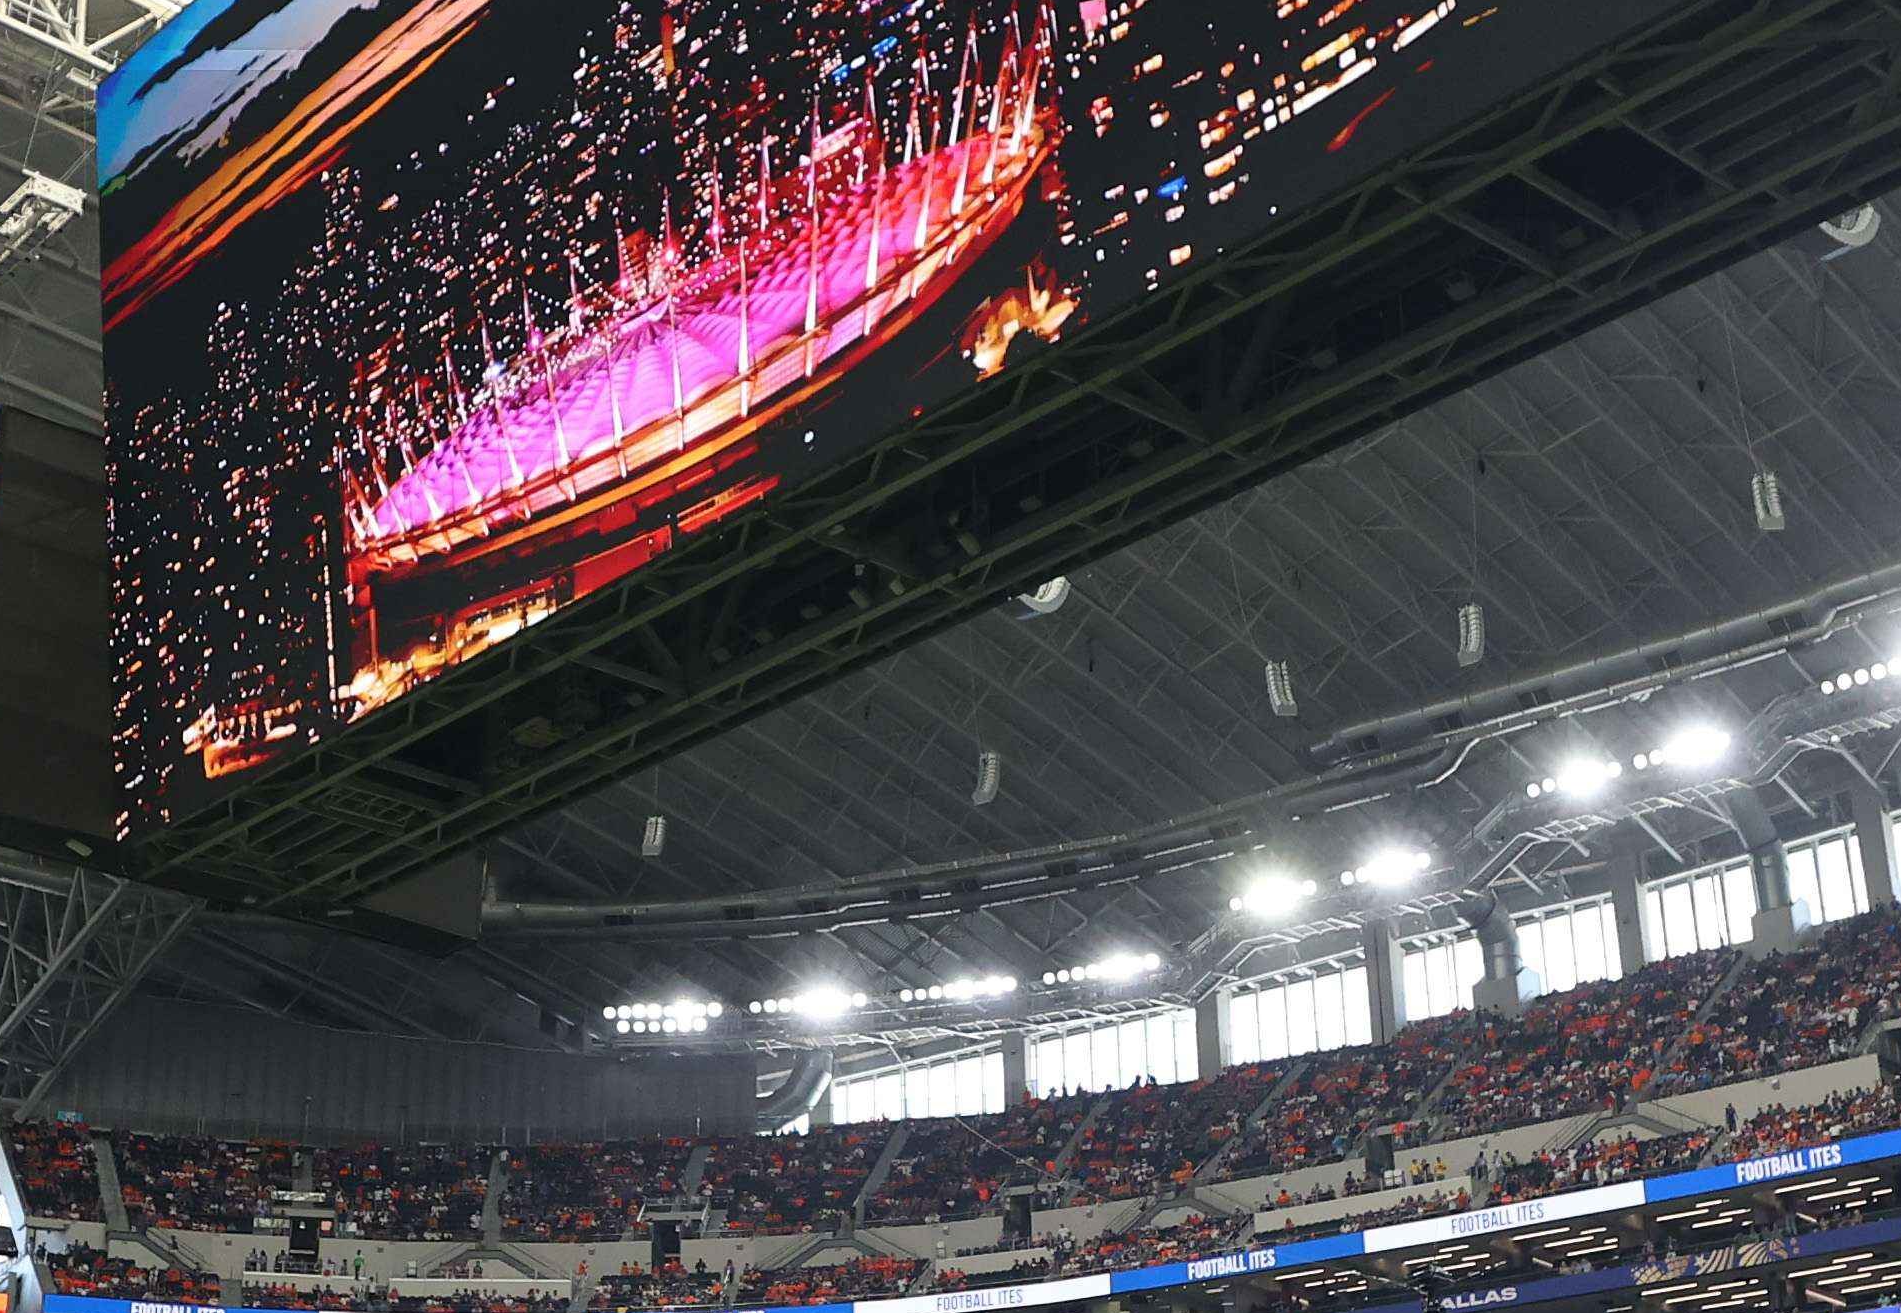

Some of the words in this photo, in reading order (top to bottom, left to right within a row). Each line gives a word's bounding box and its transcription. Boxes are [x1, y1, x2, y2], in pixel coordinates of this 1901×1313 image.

[1737, 1153, 1806, 1182] FOOTBALL
[1451, 1211, 1511, 1235] FOOTBALL
[1188, 1255, 1246, 1279] FOOTBALL
[937, 1291, 993, 1311] FOOTBALL
[1439, 1287, 1519, 1310] ALLAS
